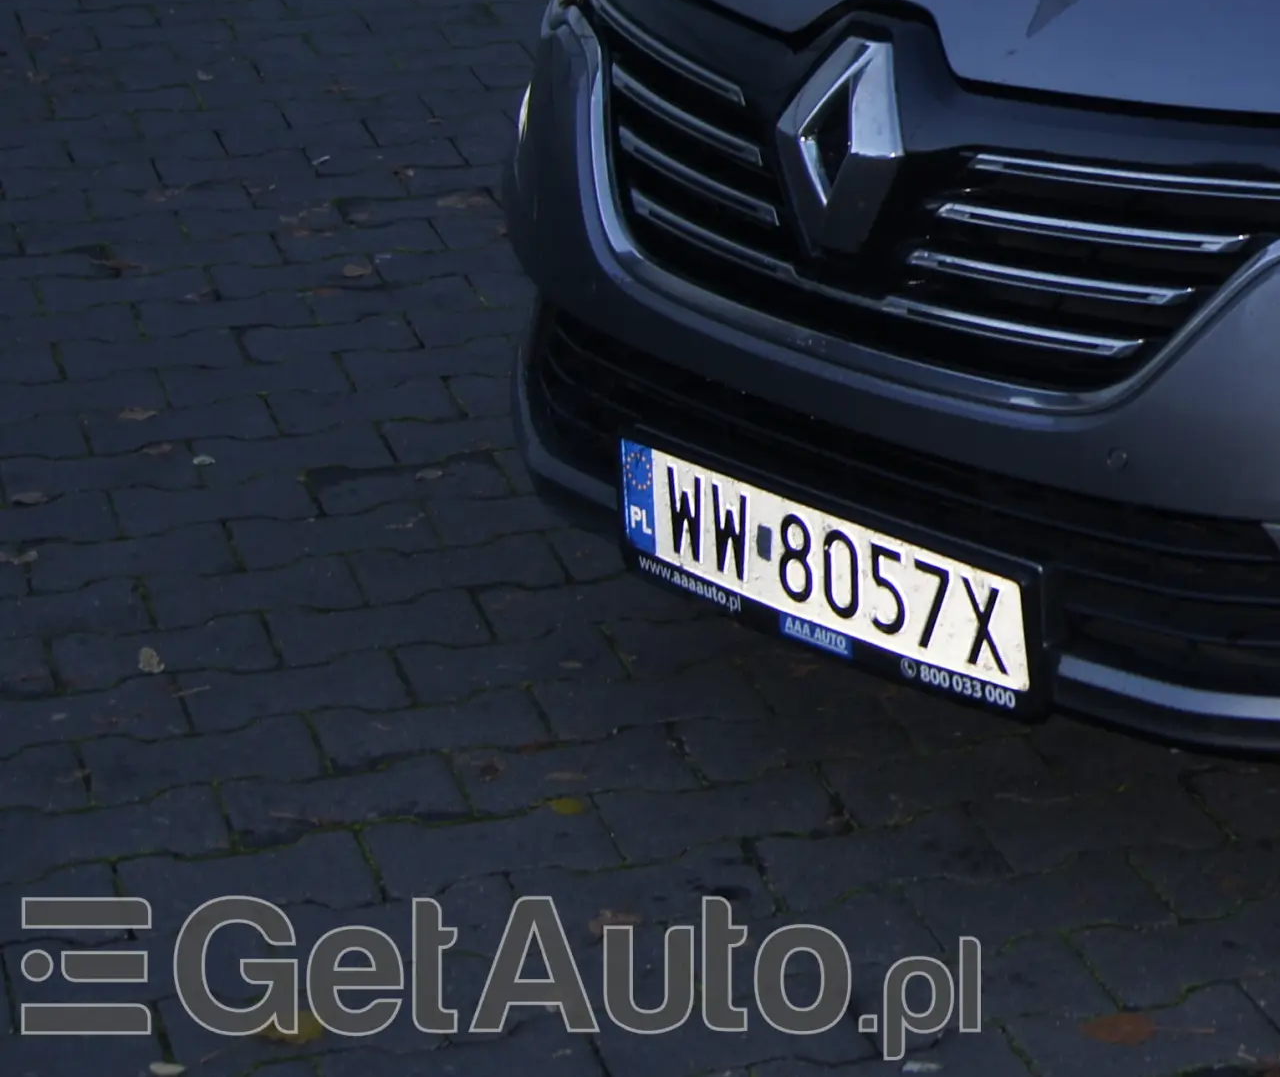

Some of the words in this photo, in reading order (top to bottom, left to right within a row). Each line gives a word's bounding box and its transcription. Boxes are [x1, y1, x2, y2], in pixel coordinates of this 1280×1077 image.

[630, 504, 653, 535] PL
[638, 555, 742, 612] www.aaaauto.pl
[667, 466, 748, 582] WW
[778, 513, 1010, 675] 8057X
[784, 616, 811, 637] AAA
[813, 623, 847, 651] AUTO
[919, 664, 950, 689] 800
[952, 674, 983, 699] 033
[984, 684, 1016, 709] 000
